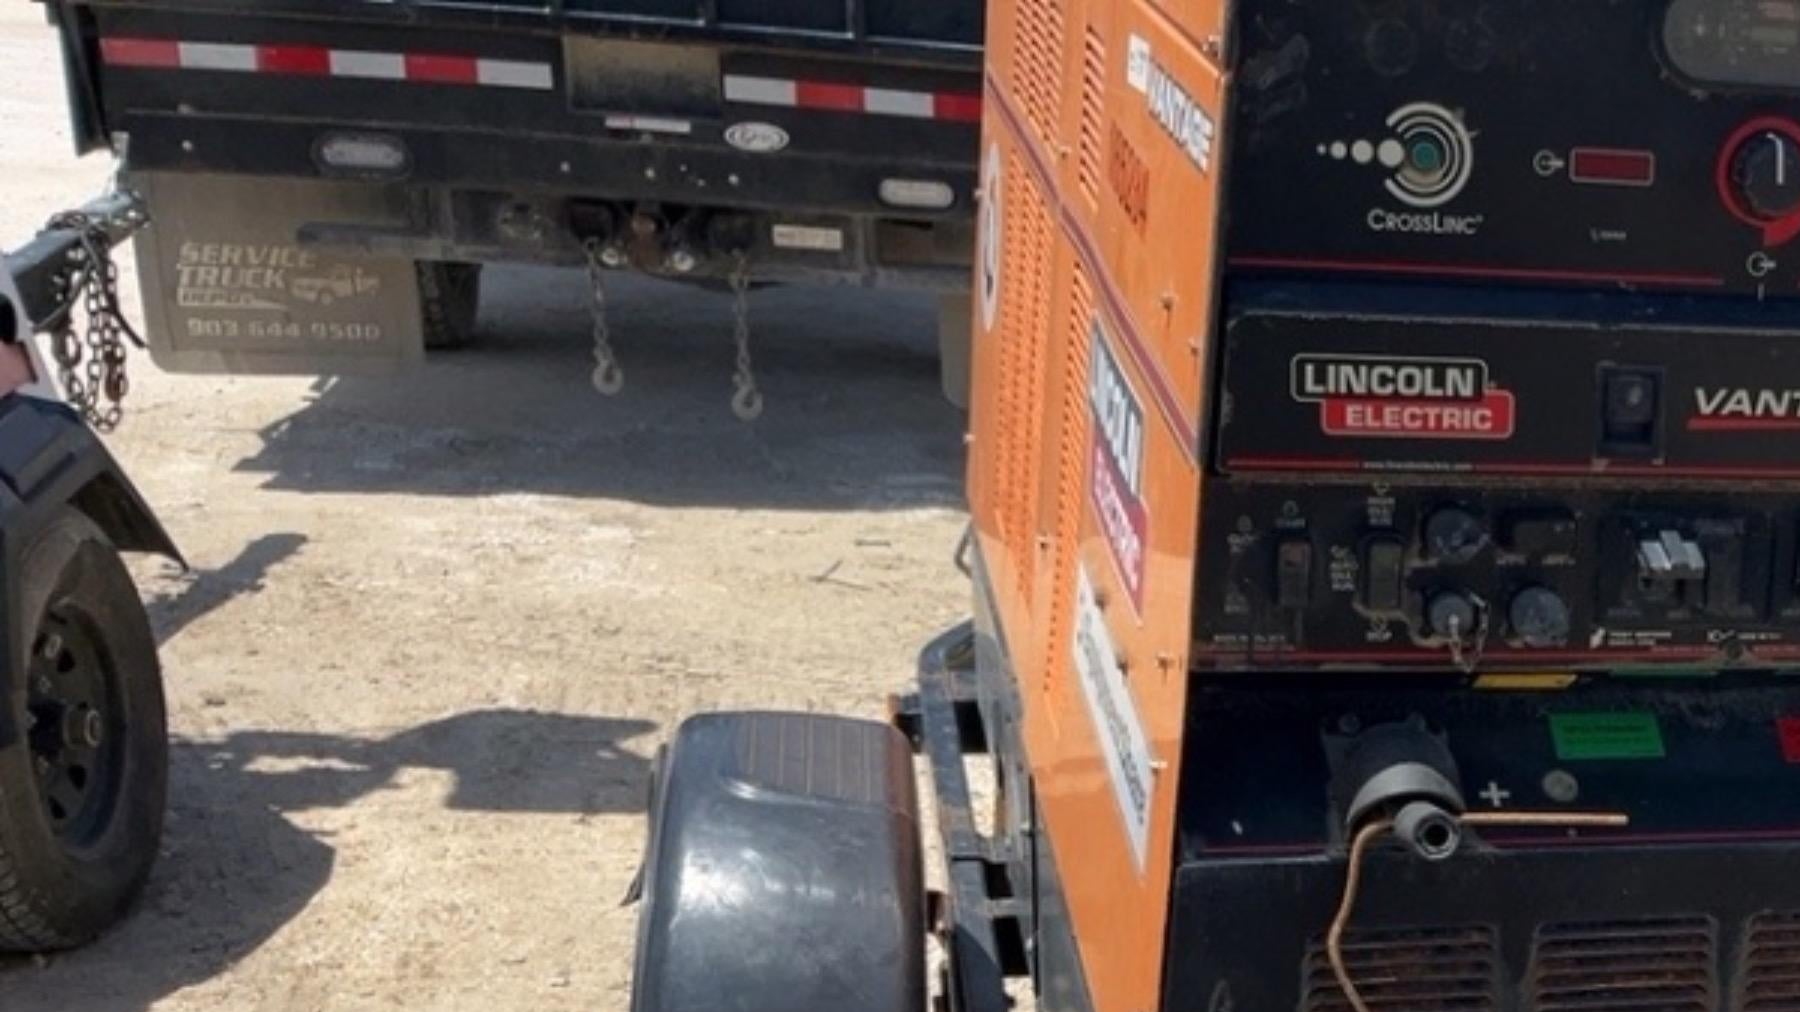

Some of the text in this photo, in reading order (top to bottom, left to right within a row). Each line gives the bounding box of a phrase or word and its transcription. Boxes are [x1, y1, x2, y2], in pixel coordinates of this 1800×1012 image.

[177, 264, 286, 290] TRUCK
[1304, 364, 1474, 397] LINCOLN
[1345, 403, 1494, 430] ELECTRIC
